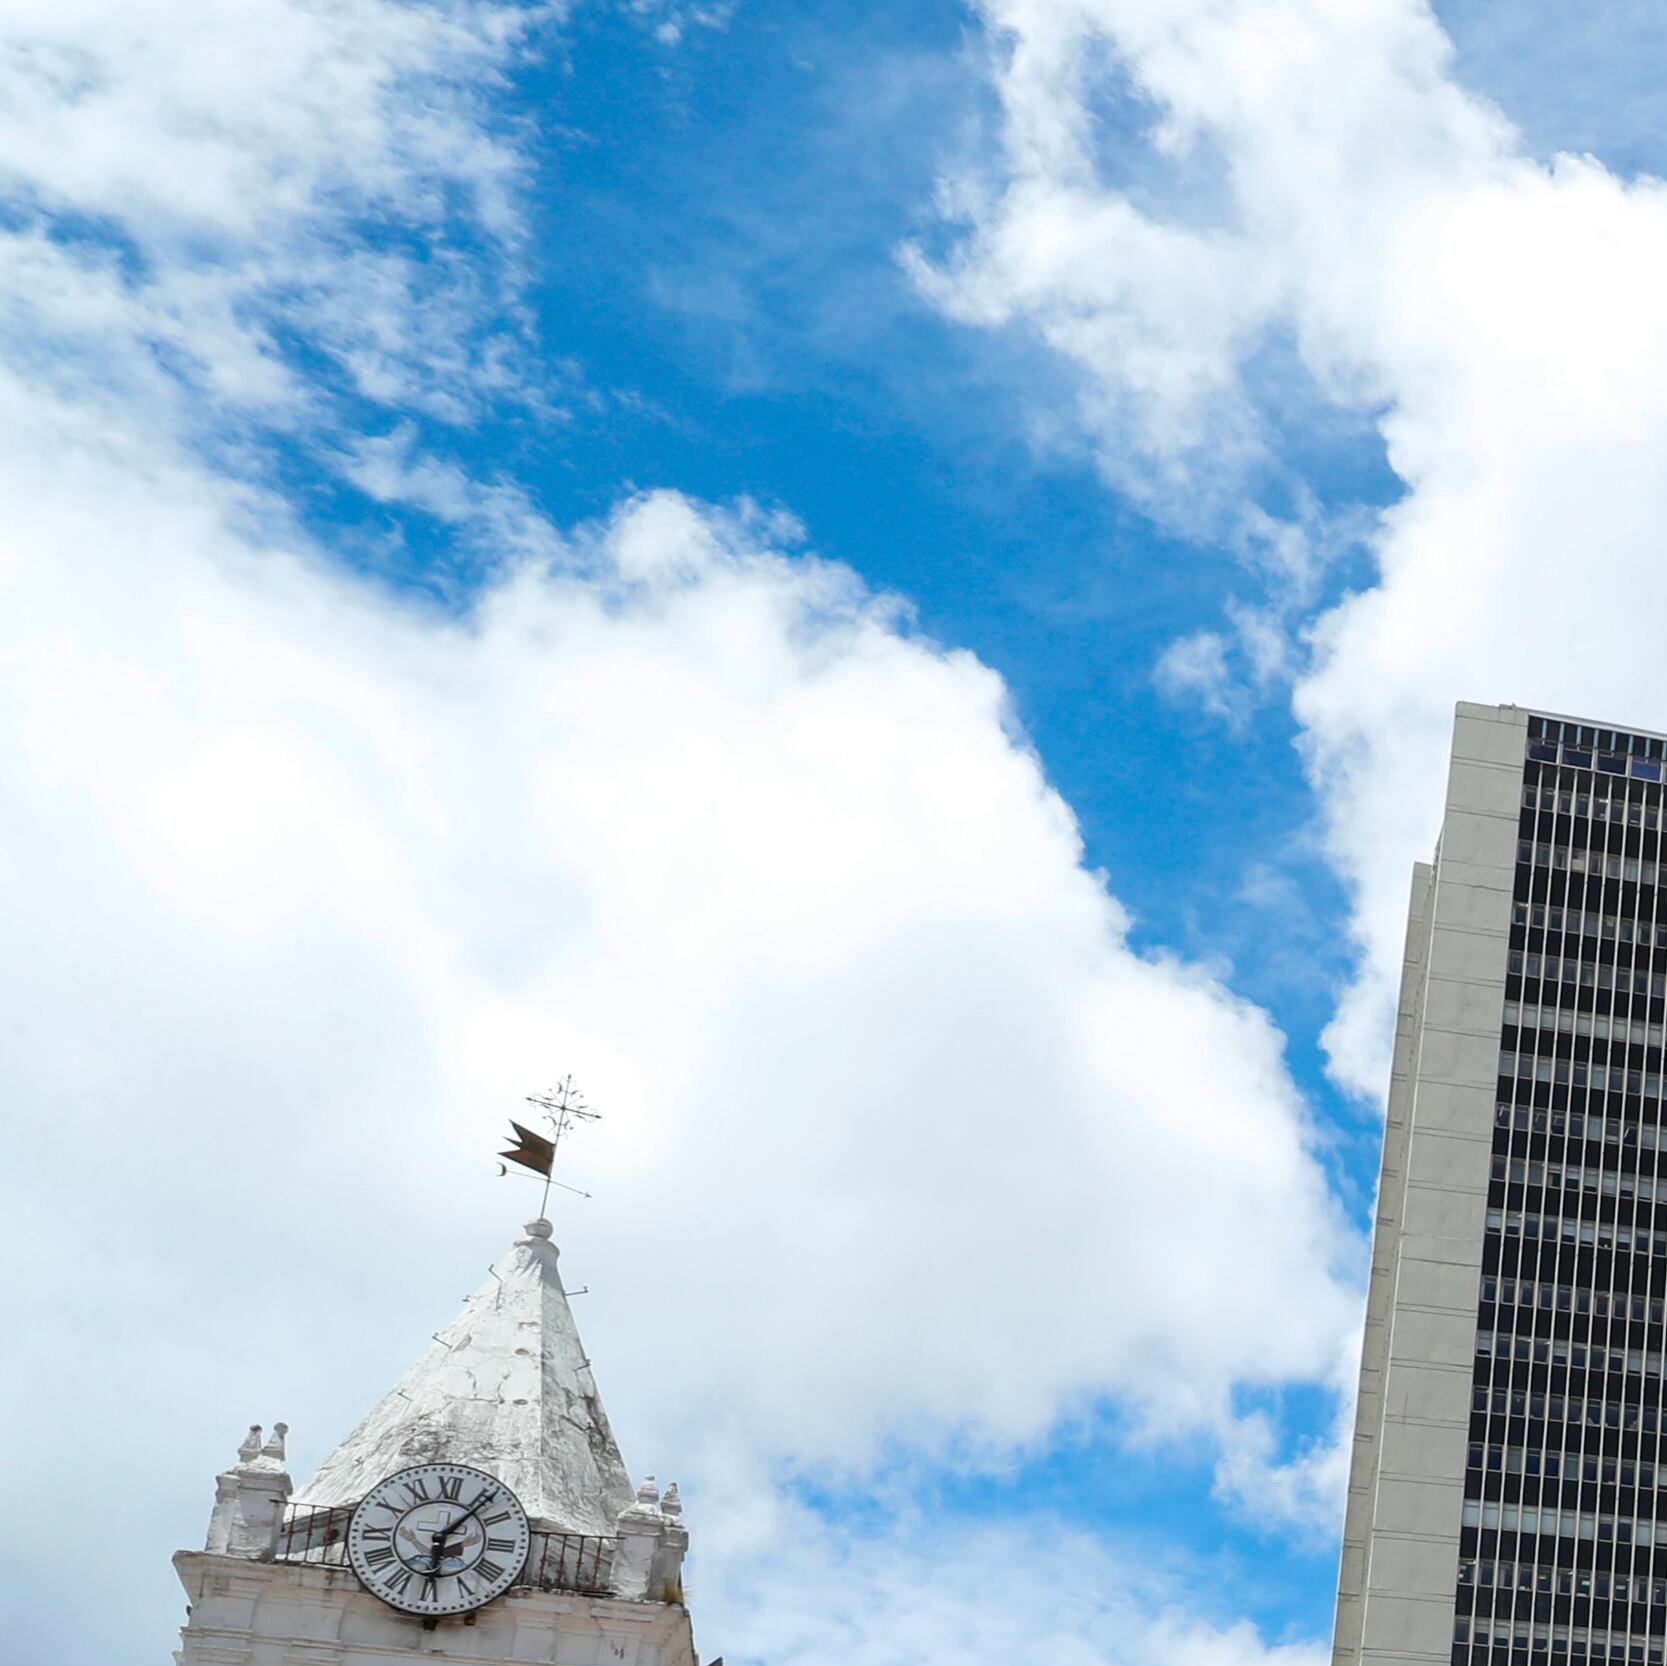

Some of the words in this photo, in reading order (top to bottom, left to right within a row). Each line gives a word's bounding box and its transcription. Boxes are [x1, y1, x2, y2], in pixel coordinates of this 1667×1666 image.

[403, 1478, 430, 1505] XI
[437, 1475, 463, 1500] XII
[377, 1497, 405, 1519] X
[483, 1511, 512, 1527] II
[487, 1537, 515, 1553] III
